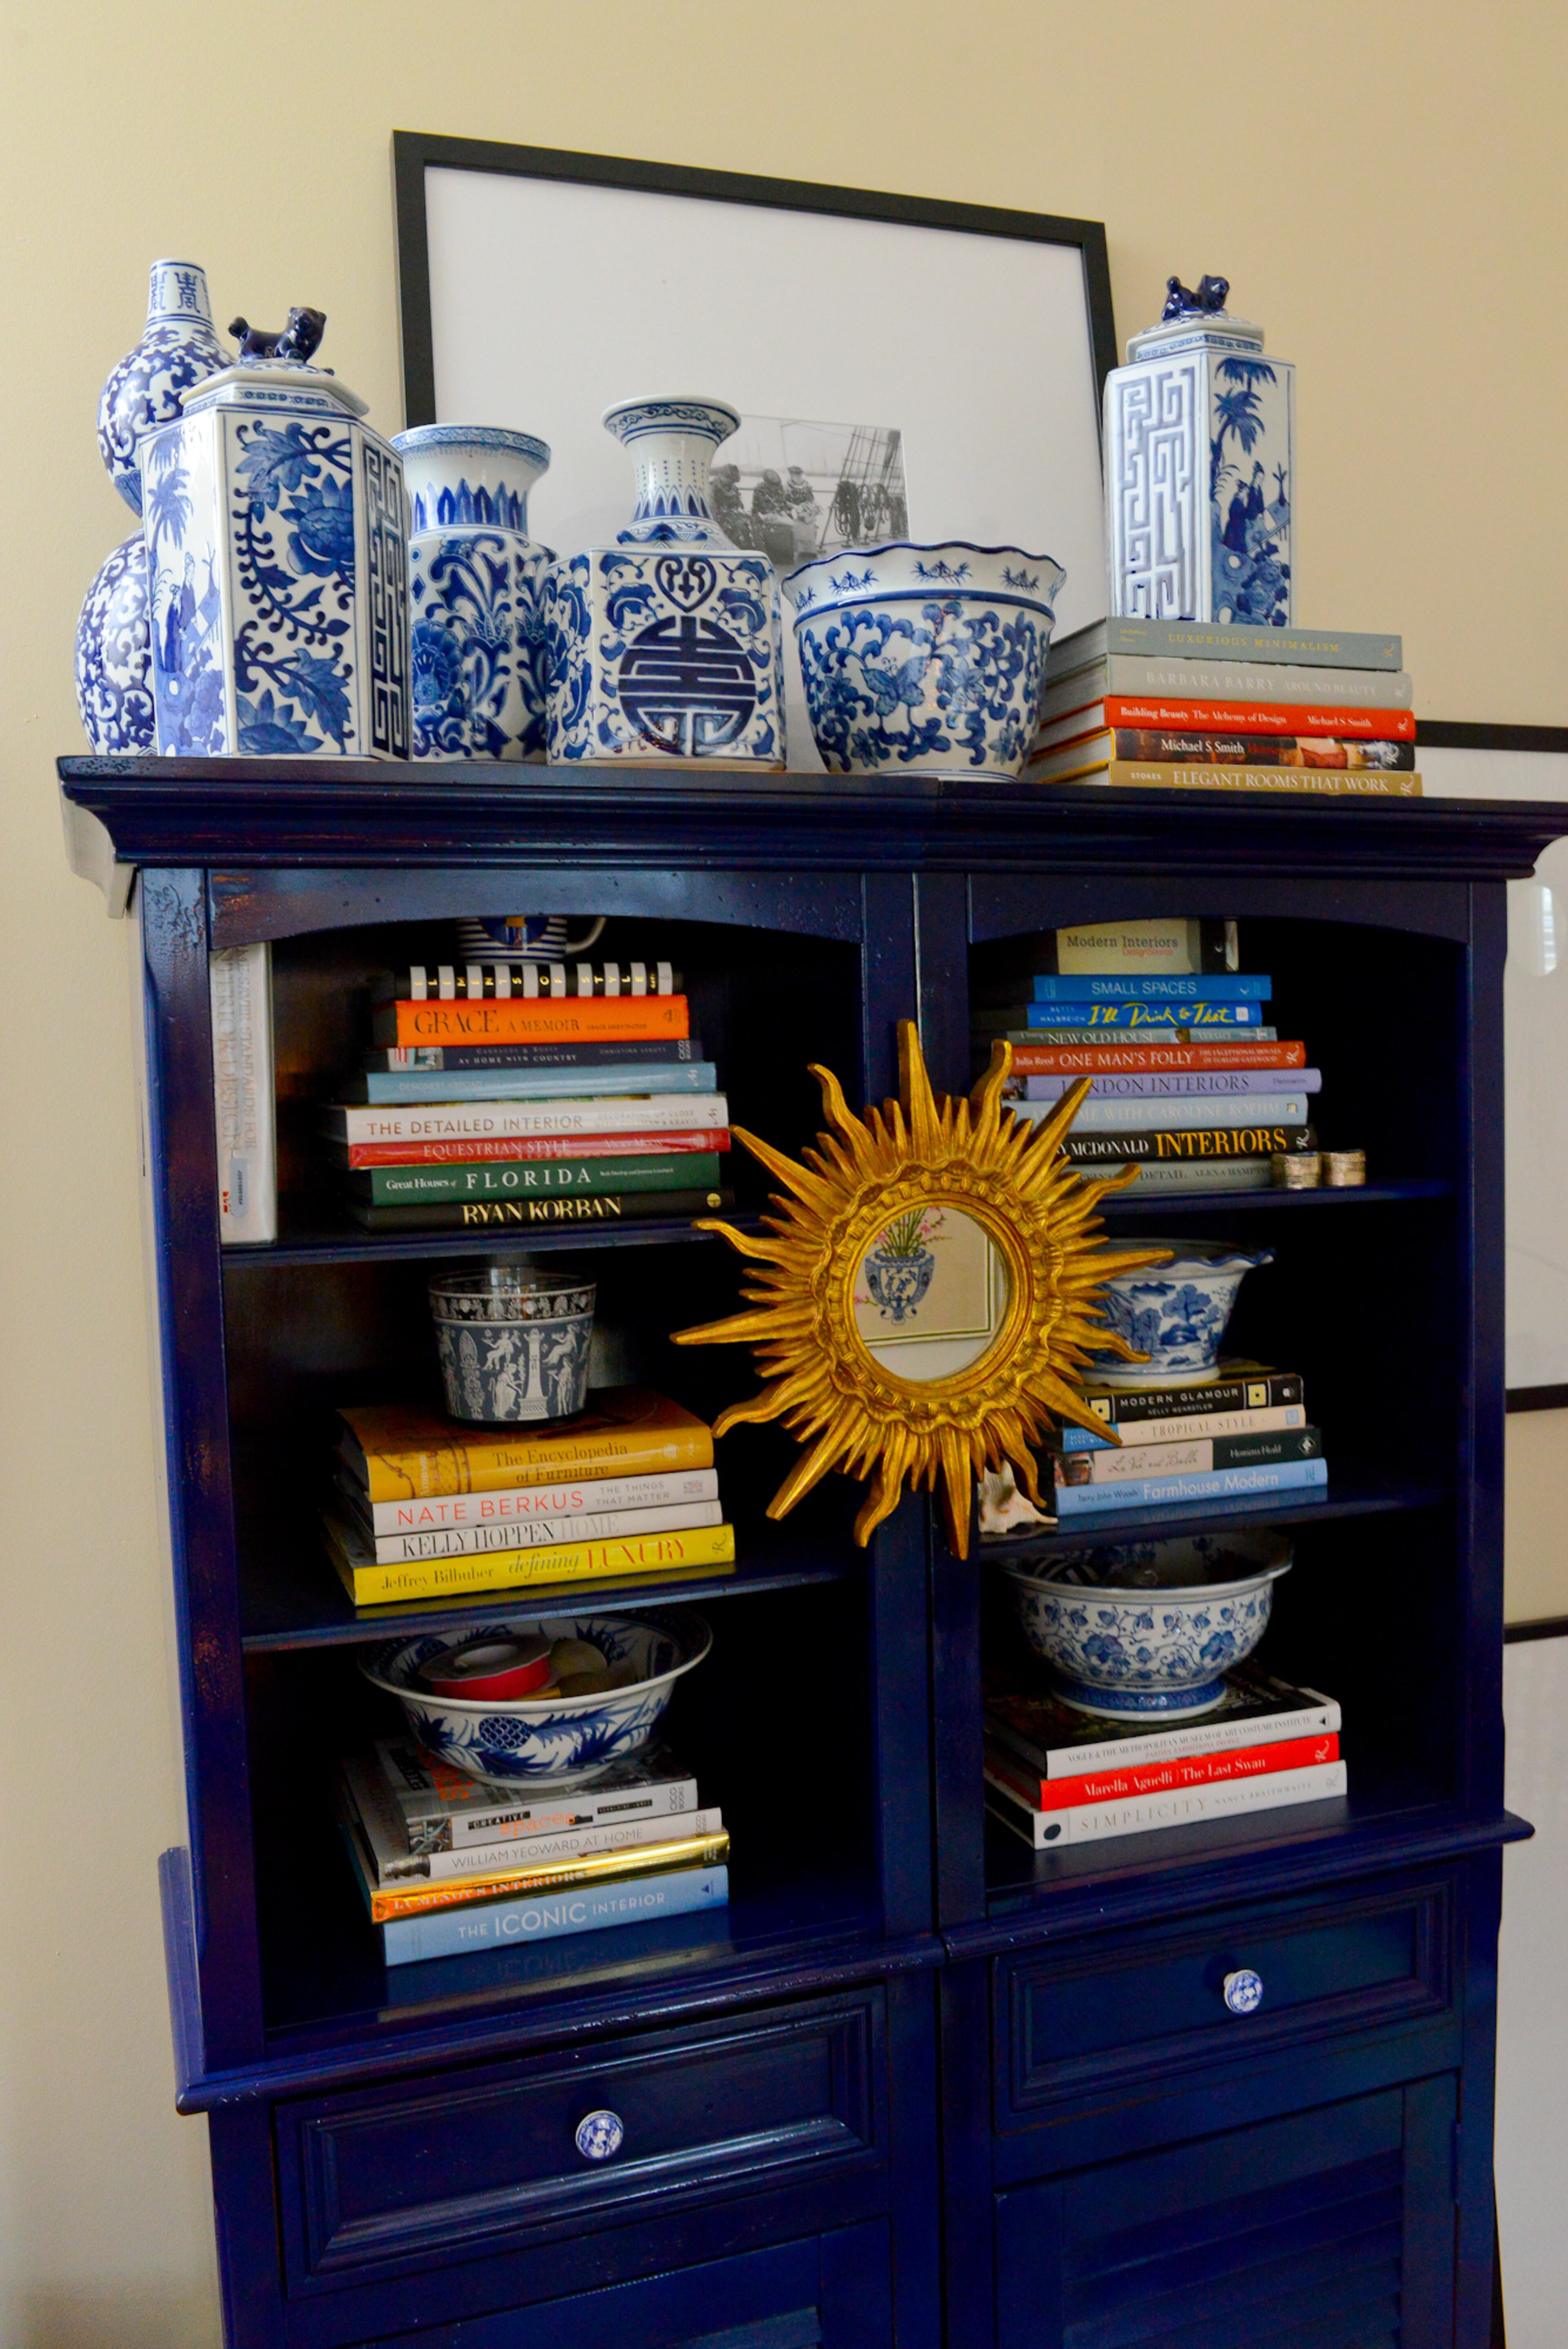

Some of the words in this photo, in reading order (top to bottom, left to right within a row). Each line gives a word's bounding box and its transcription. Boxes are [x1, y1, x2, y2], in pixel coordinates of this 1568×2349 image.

[1168, 633, 1247, 646] LUXURIOUS
[1255, 639, 1339, 652] MINIMALISM
[1146, 672, 1220, 688] BARBARA
[1225, 676, 1274, 691] BARRY
[1286, 681, 1332, 693] AROUND
[1334, 685, 1376, 695] BEAUTY
[1121, 706, 1158, 720] Building
[1160, 708, 1188, 720] Beauty
[1192, 710, 1209, 720] The
[1212, 711, 1245, 724] Alchemy
[1247, 713, 1258, 721] of
[1258, 713, 1286, 726] Design
[1307, 715, 1338, 726] Michael
[1348, 717, 1372, 728] Smith
[1161, 739, 1203, 753] Michael
[1214, 740, 1245, 754] Smith
[1131, 772, 1162, 781] STOKES
[1173, 770, 1242, 788] ELEGANT
[1246, 773, 1298, 789] ROOMS
[1300, 775, 1343, 790] THAT
[1345, 777, 1390, 792] WORK
[1067, 936, 1117, 948] Modern
[1122, 935, 1178, 948] Interiors
[414, 977, 522, 987] ELEMENTS
[539, 975, 563, 986] OF
[581, 975, 644, 984] STYLE
[1091, 981, 1138, 995] SMALL
[1142, 981, 1197, 995] SPACES
[215, 948, 237, 1054] NTERIOR
[414, 1010, 499, 1034] GRACE
[507, 1020, 516, 1032] A
[521, 1019, 580, 1033] MEMOIR
[1122, 1002, 1180, 1028] Drink
[1192, 1002, 1235, 1025] That
[1048, 1033, 1080, 1044] NEW
[1082, 1032, 1110, 1044] OLD
[1112, 1032, 1156, 1043] HOUSE
[1016, 1056, 1033, 1066] Julia
[1035, 1055, 1054, 1066] Reed
[1059, 1053, 1093, 1067] ONE
[1098, 1051, 1146, 1066] MAN'S
[1150, 1050, 1194, 1065] FOLLY
[1062, 1078, 1143, 1095] LNDON
[1151, 1075, 1249, 1093] INTERIORS
[1103, 1107, 1142, 1122] WITH
[1148, 1104, 1222, 1120] CAROLYNE
[1229, 1102, 1280, 1117] ROEHM
[367, 1121, 402, 1136] THE
[410, 1118, 494, 1134] DETAILED
[503, 1115, 583, 1131] INTERIOR
[423, 1141, 523, 1160] EQUESTRIAN
[527, 1138, 570, 1153] STYLE
[1071, 1140, 1149, 1156] MCDONALD
[1154, 1128, 1287, 1158] INTERIORS
[386, 1179, 413, 1190] Great
[414, 1178, 450, 1188] Houses
[466, 1167, 592, 1189] FLORIDA
[461, 1202, 523, 1225] RYAN
[528, 1196, 622, 1221] KORBAN
[1120, 1394, 1174, 1407] MODERN
[1180, 1387, 1239, 1402] GLAMOUR
[1152, 1419, 1212, 1437] TROPICAL
[1217, 1416, 1254, 1429] STYLE
[492, 1451, 523, 1467] The
[527, 1442, 628, 1465] Encyclopedia
[419, 1454, 429, 1496] Aronson
[517, 1468, 534, 1483] of
[536, 1465, 609, 1481] Furniture
[1144, 1478, 1221, 1500] Farmhouse
[1225, 1470, 1279, 1490] Modern
[625, 1481, 664, 1492] THINGS
[398, 1503, 467, 1526] NATE
[481, 1490, 584, 1518] BERKUS
[596, 1496, 622, 1506] THAT
[627, 1492, 670, 1503] MATTER
[402, 1531, 467, 1557] KELLY
[474, 1521, 554, 1549] HOPPEN
[560, 1515, 620, 1539] HOME
[381, 1574, 428, 1591] Jeffrey
[434, 1566, 494, 1584] Bilhuber
[508, 1552, 580, 1579] defining
[588, 1539, 684, 1569] LUXURY
[1067, 1750, 1092, 1763] VOGUE
[1102, 1748, 1117, 1757] THE
[1118, 1738, 1178, 1755] METROPOLITAN
[1178, 1733, 1211, 1745] MUSEUM
[1224, 1728, 1238, 1736] ART
[1238, 1723, 1273, 1734] COSTUME
[1274, 1716, 1312, 1728] INSTITUTE
[1085, 1779, 1128, 1796] Marella
[1134, 1770, 1173, 1792] Agnelli
[1180, 1767, 1205, 1781] The
[1208, 1763, 1232, 1777] Last
[1235, 1758, 1266, 1772] Swan
[474, 1812, 525, 1828] CREATIVE
[499, 1812, 576, 1837] spaces
[1081, 1797, 1207, 1832] SIMPLICITY
[452, 1849, 508, 1868] WILLIAM
[510, 1838, 580, 1859] YEOWARD
[583, 1835, 599, 1847] AT
[604, 1828, 643, 1844] HOME
[393, 1886, 486, 1911] LUMINOUS
[492, 1871, 586, 1895] INTERIORS
[458, 1922, 489, 1939] THE
[494, 1902, 586, 1937] ICONIC
[592, 1892, 666, 1916] INTERIOR
